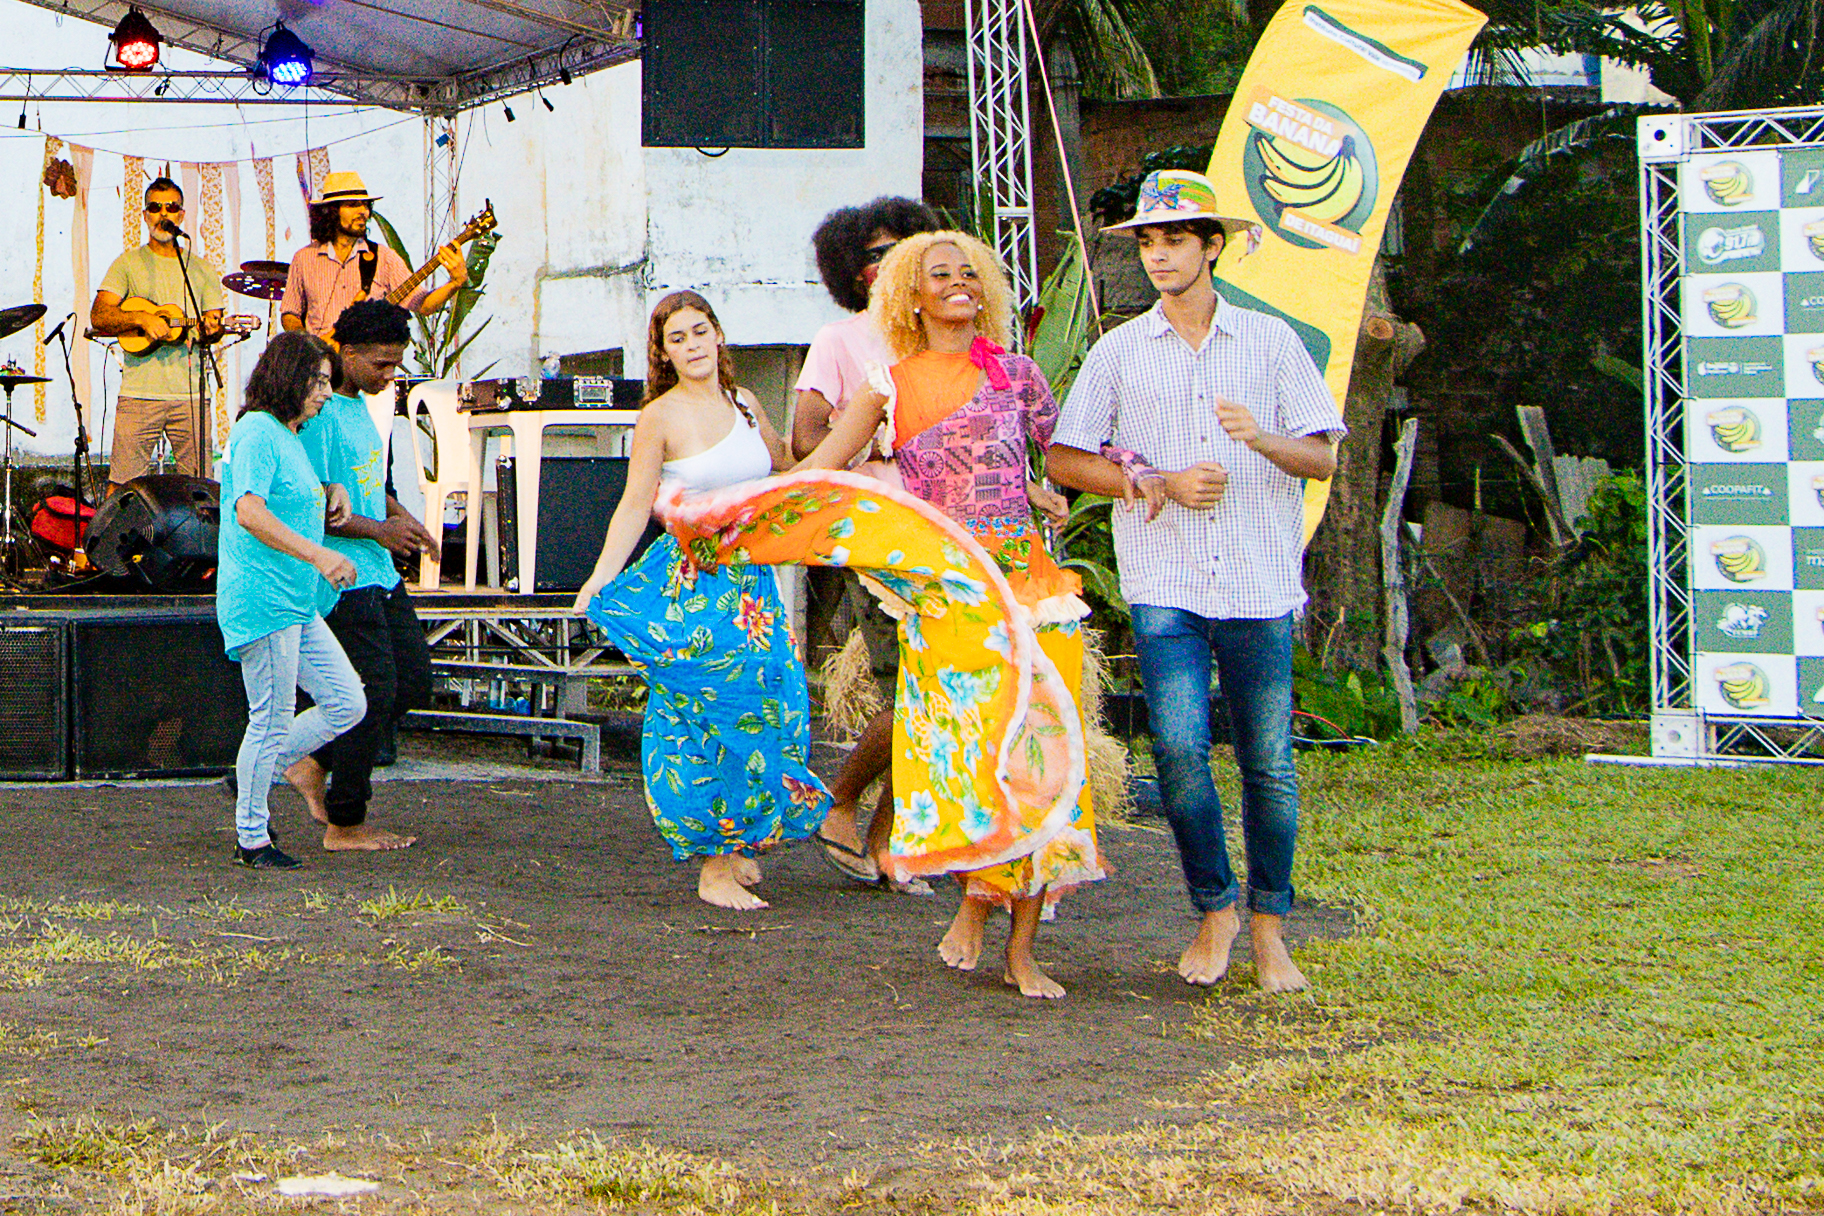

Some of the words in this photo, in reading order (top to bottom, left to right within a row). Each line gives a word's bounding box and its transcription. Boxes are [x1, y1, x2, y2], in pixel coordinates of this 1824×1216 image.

[1248, 101, 1343, 156] BANANA
[1268, 95, 1314, 126] FESTA
[1312, 116, 1333, 134] DA
[1284, 213, 1304, 229] DE
[1303, 222, 1360, 254] ITAGUAÍ
[1710, 485, 1764, 495] COOPAFIT
